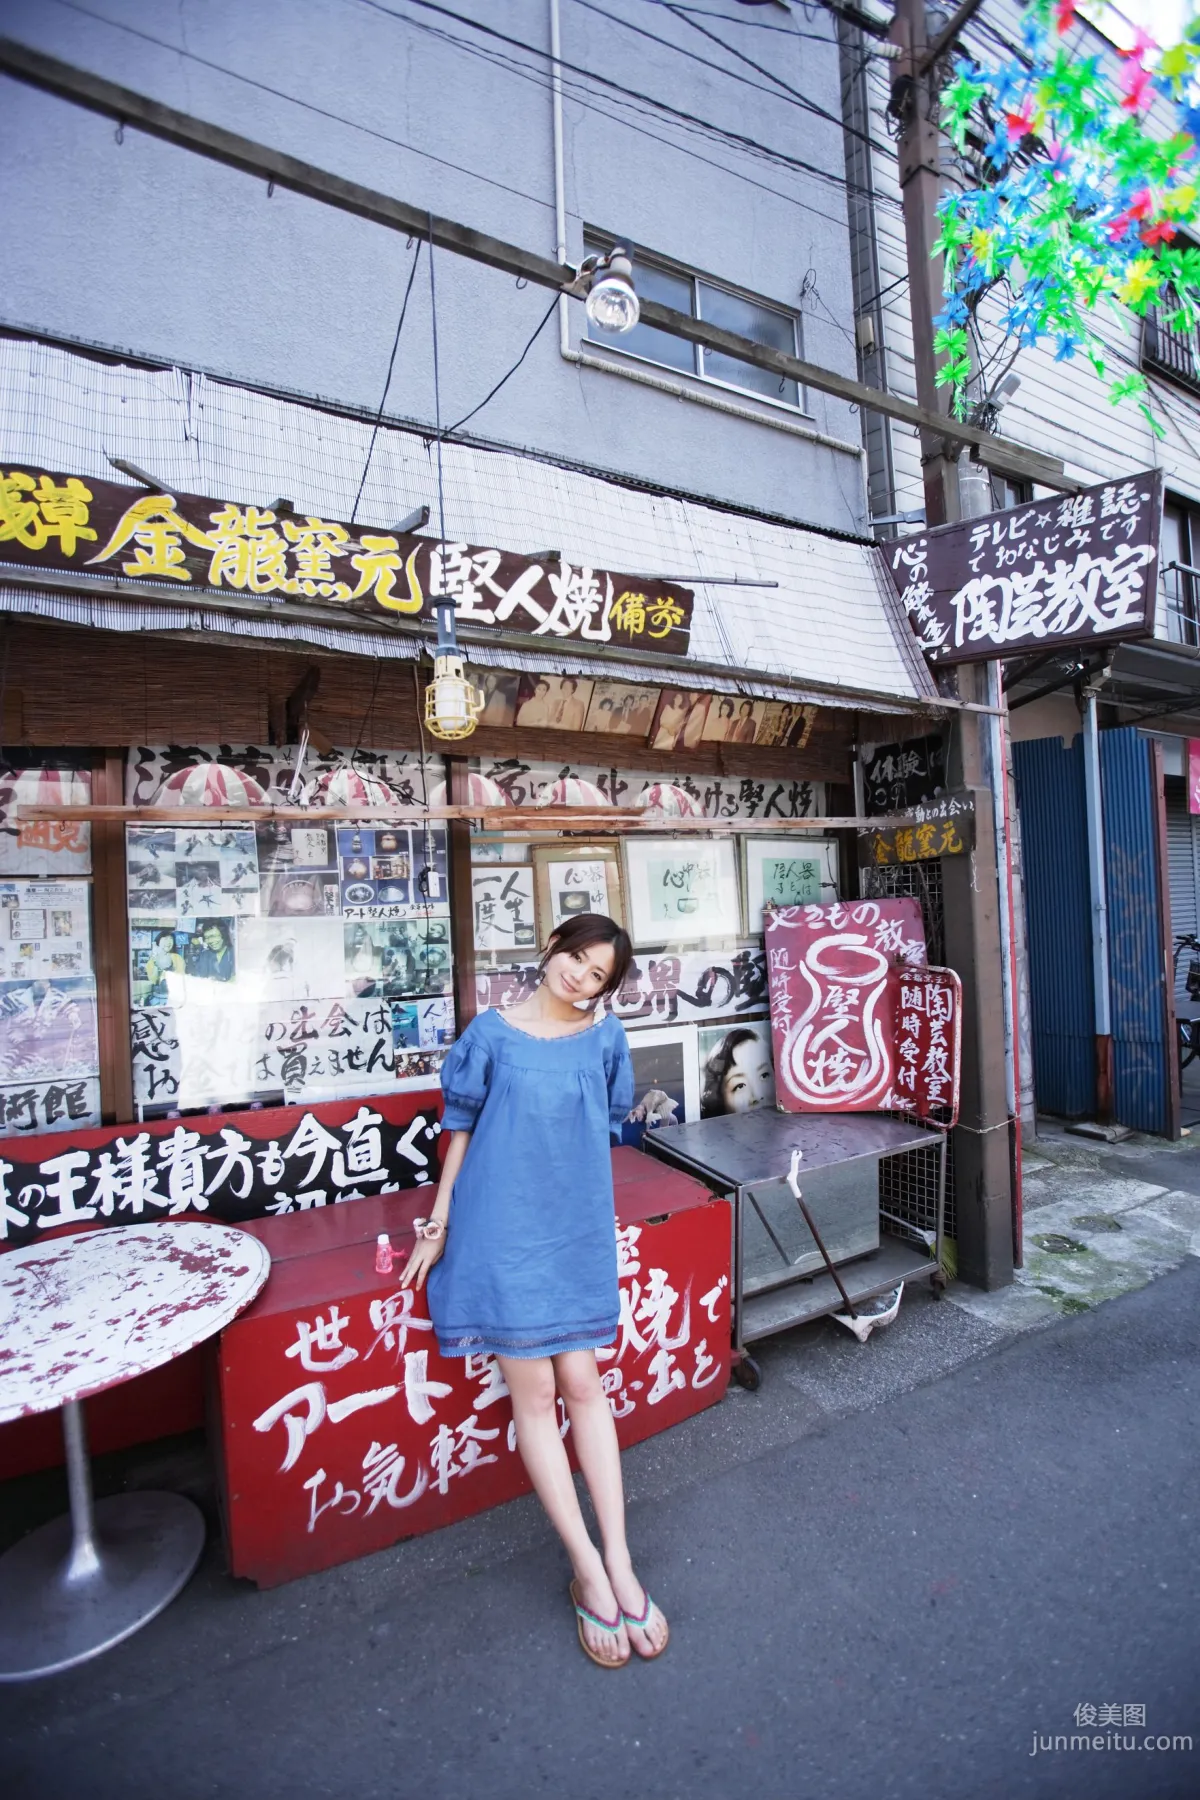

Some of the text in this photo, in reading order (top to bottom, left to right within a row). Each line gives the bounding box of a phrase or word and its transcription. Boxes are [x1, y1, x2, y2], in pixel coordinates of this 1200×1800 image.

[949, 543, 1157, 648] 陶芸教室
[968, 515, 1141, 572] でおなじみです
[897, 985, 926, 1092] 随時受付
[920, 983, 953, 1104] 陶芸教室
